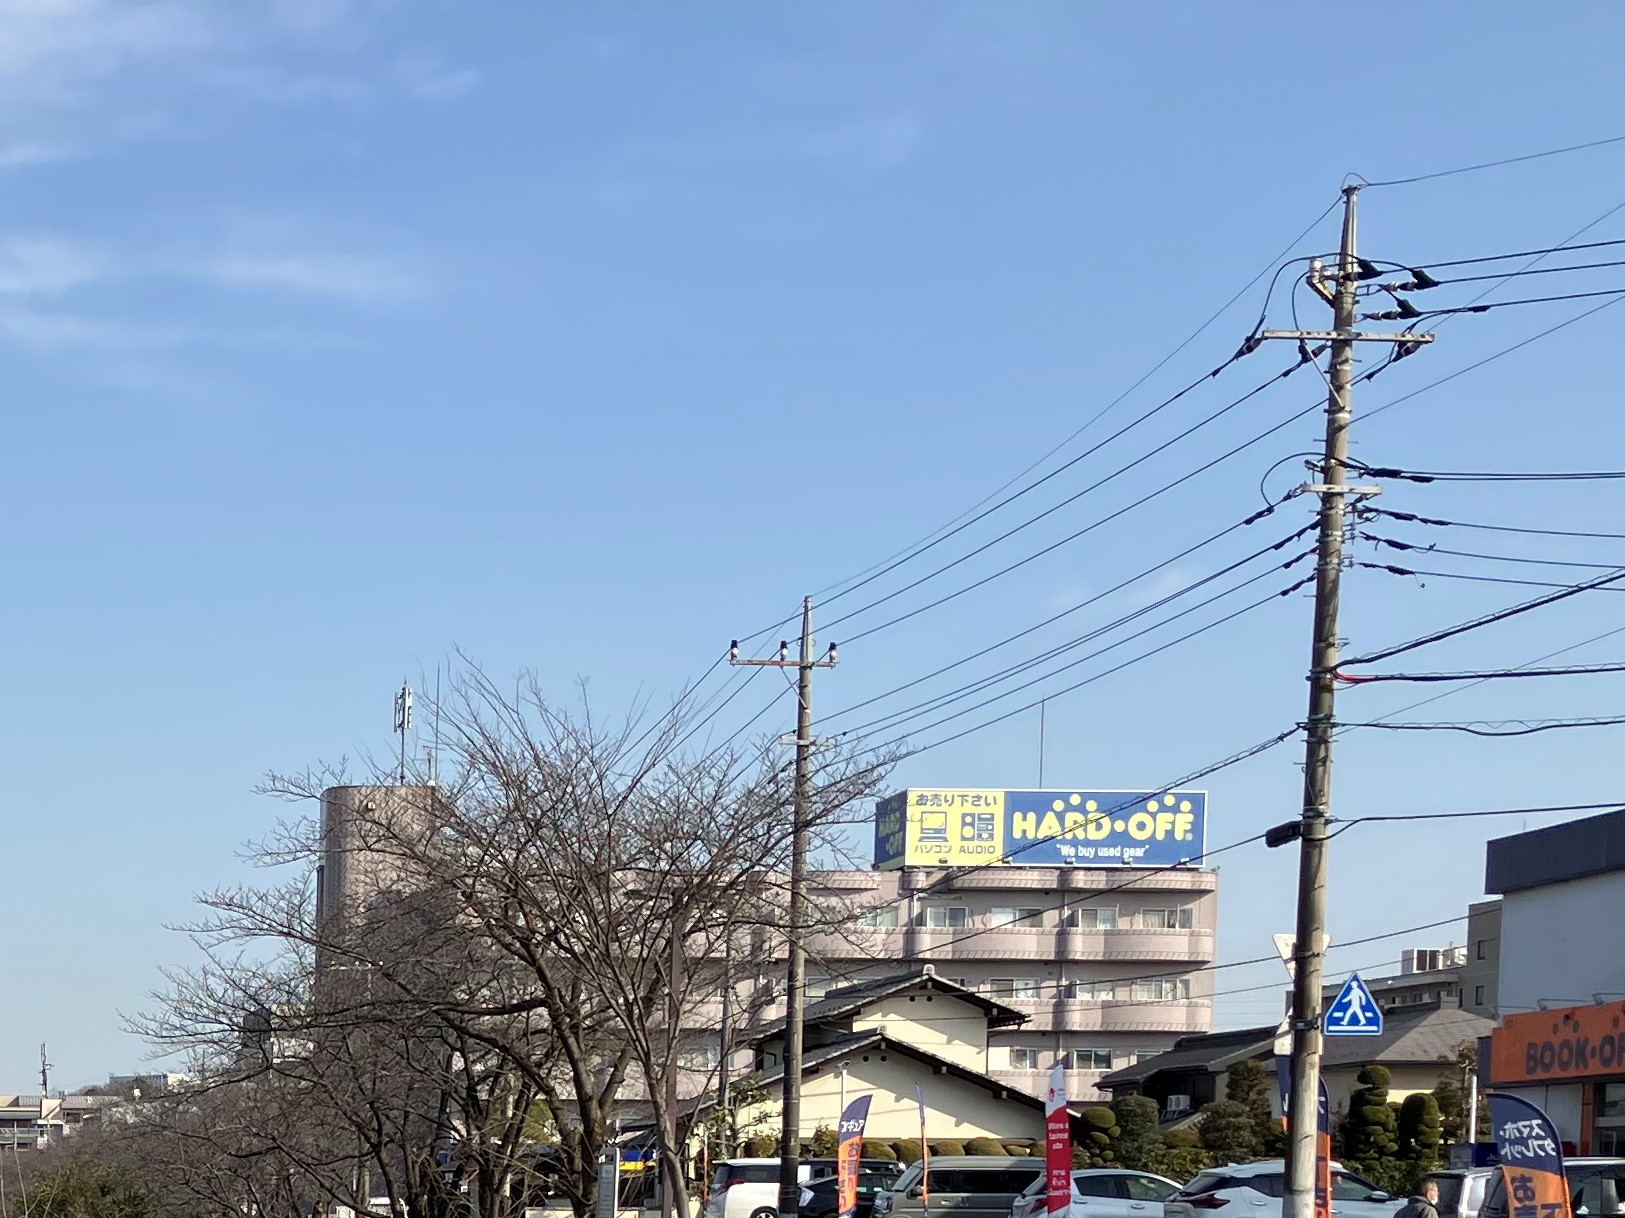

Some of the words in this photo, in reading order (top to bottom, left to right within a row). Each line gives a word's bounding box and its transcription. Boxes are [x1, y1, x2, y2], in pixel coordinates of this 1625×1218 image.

[916, 793, 997, 807] お売り下さい
[914, 845, 952, 854] パソコン
[958, 845, 995, 854] AUDIO
[1078, 846, 1095, 858] buy
[1098, 846, 1121, 857] used
